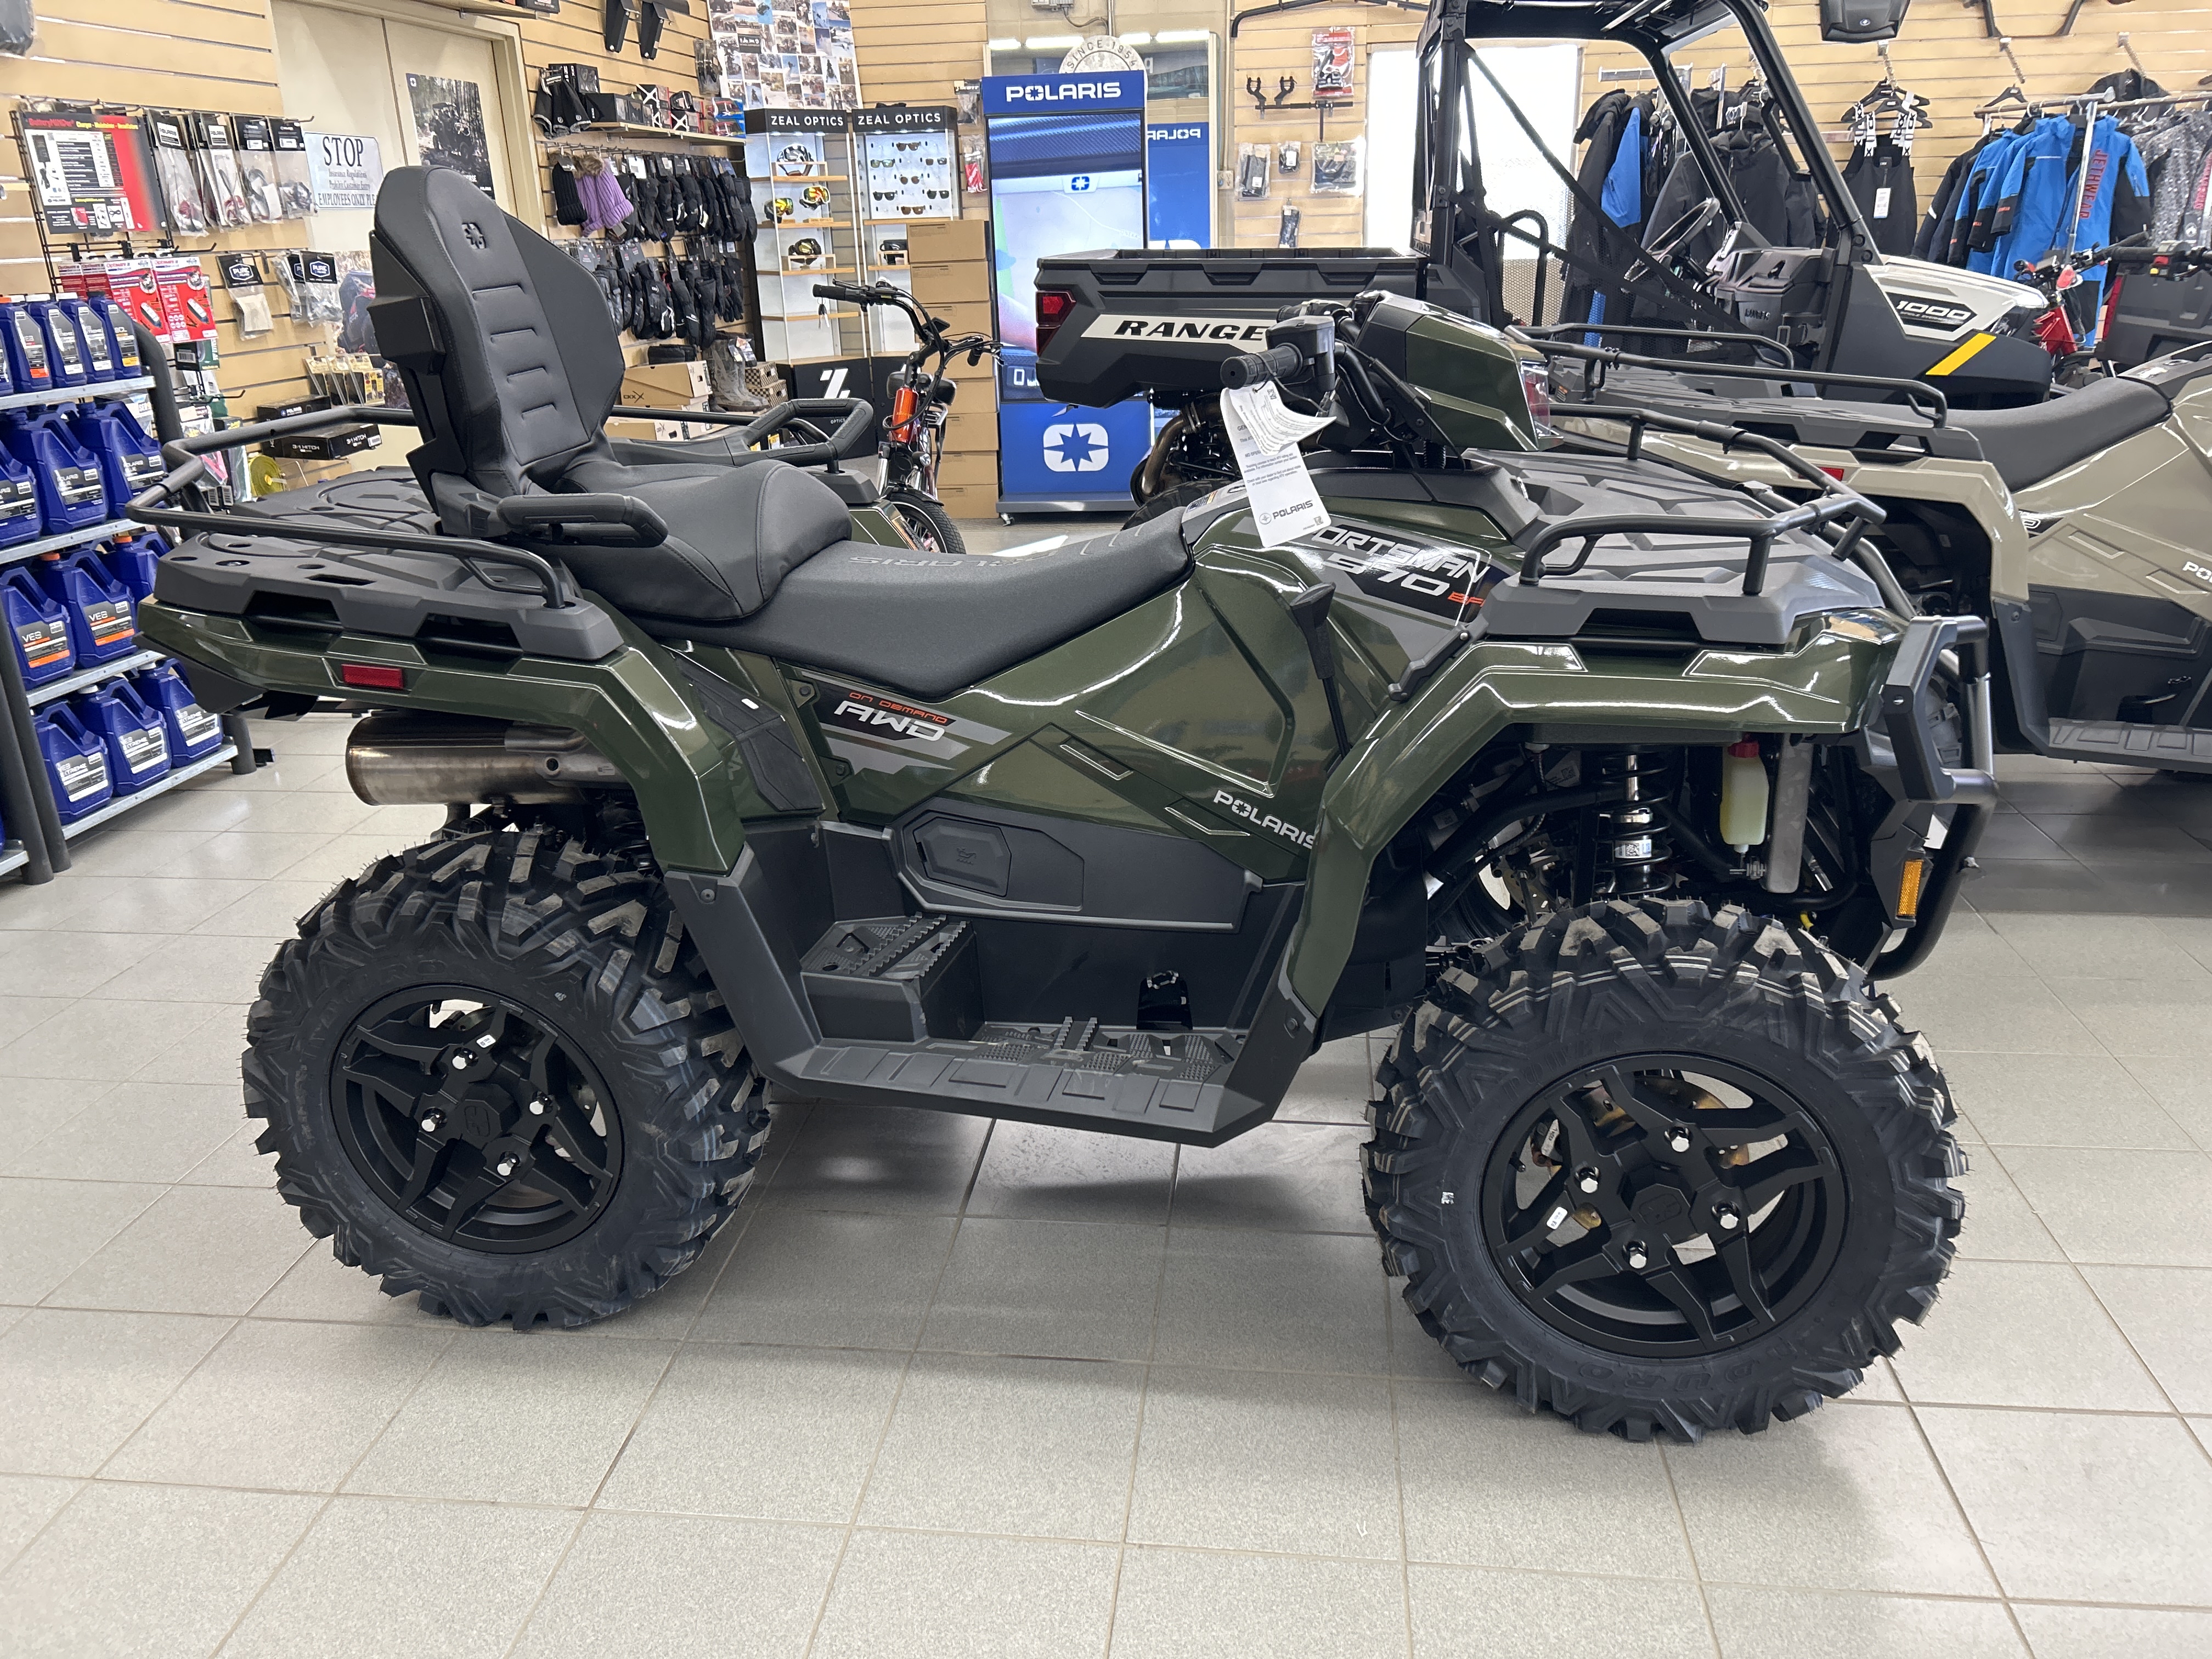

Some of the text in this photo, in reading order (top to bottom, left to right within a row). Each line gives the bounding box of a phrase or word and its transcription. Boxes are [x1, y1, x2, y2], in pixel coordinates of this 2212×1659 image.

[1066, 39, 1138, 69] SINCE 1954
[1005, 82, 1121, 103] POLARIS
[771, 116, 844, 126] ZEAL OPTICS
[857, 113, 941, 125] ZEAL OPTICS
[323, 136, 363, 167] STOP
[2079, 149, 2109, 219] JETHWEAR
[318, 193, 375, 206] EMPLOYEES ONLY PLE
[1896, 301, 1971, 320] 1000
[1114, 320, 1268, 341] RANGE
[1272, 500, 1314, 520] POLARIS
[1311, 526, 1491, 583] ORTSMAN
[1322, 552, 1451, 596] 570
[88, 611, 108, 622] VES
[21, 631, 43, 643] VES
[833, 700, 946, 742] AWD
[1213, 790, 1318, 849] POLARIS
